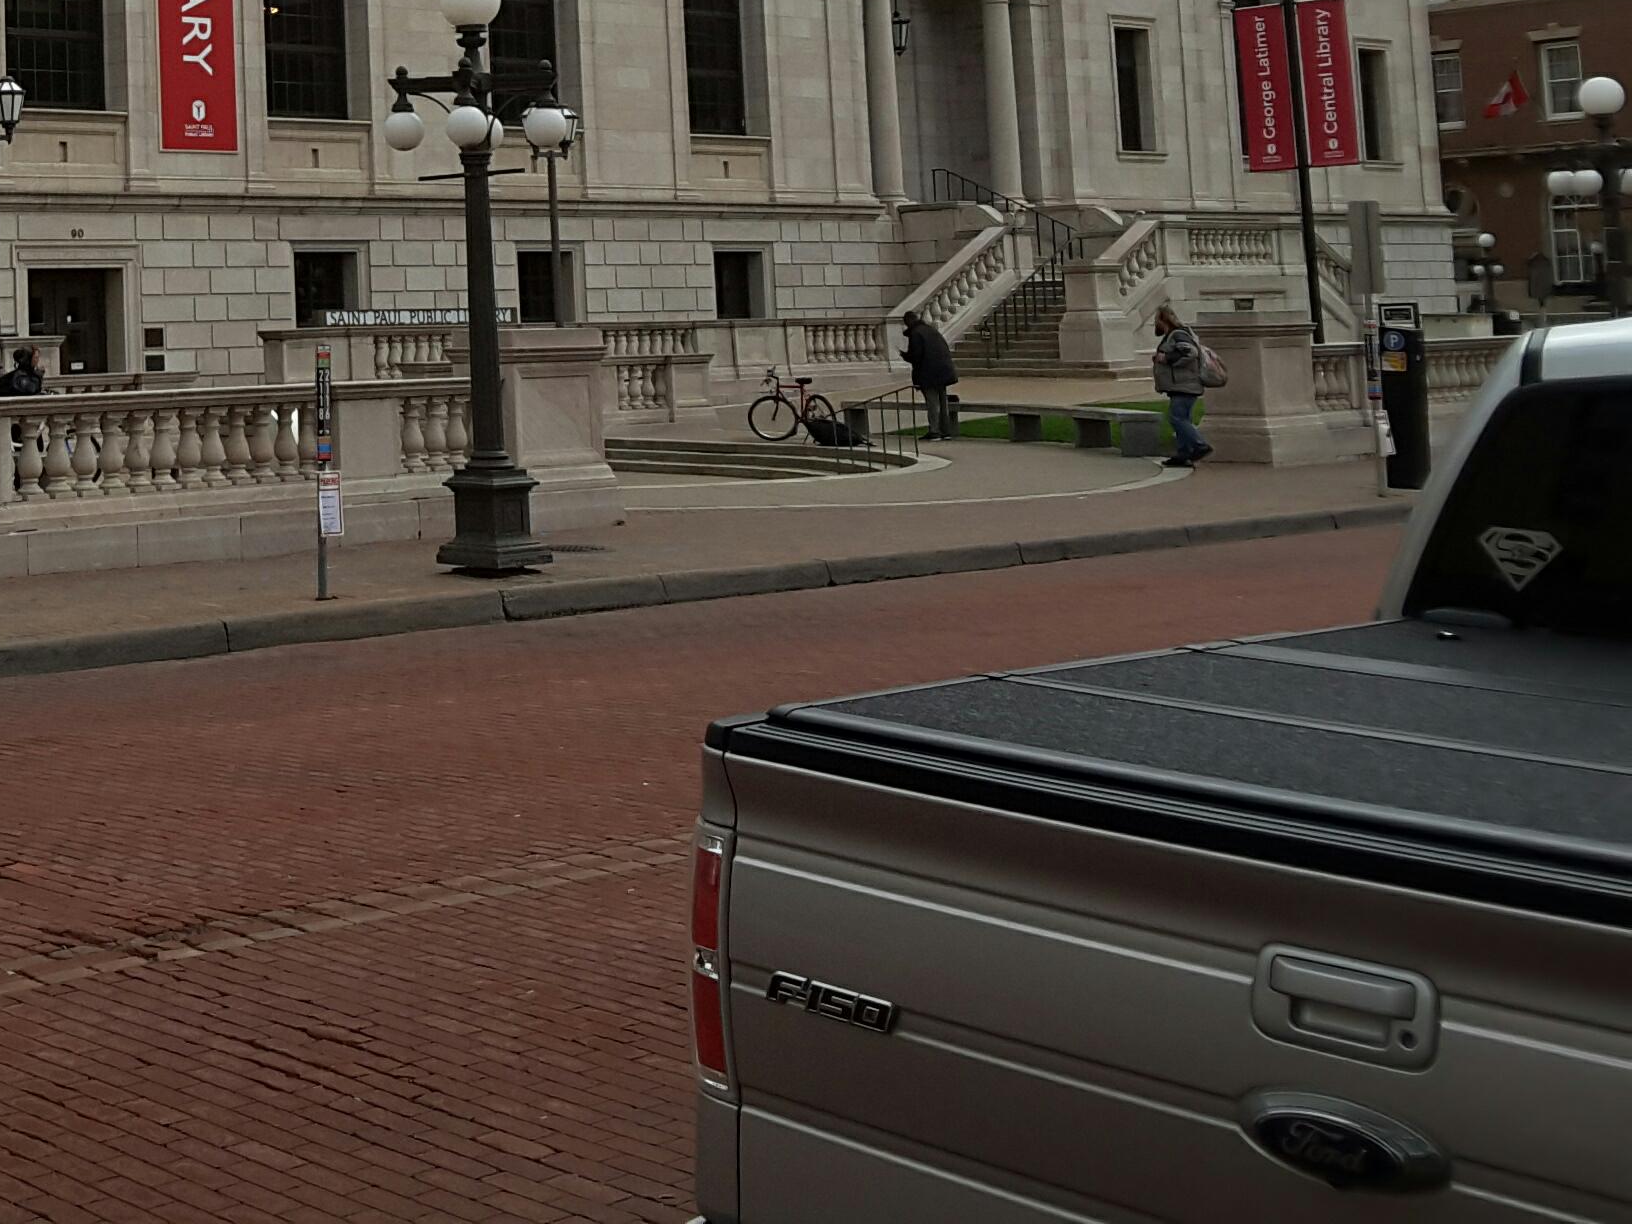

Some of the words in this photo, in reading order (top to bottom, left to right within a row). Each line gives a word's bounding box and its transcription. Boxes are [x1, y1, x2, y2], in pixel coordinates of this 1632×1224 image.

[1254, 15, 1271, 76] Latimer
[1315, 8, 1333, 67] Library
[1261, 79, 1276, 139] George
[1317, 73, 1338, 134] Central
[70, 228, 85, 239] 90
[330, 311, 368, 326] SAINT
[373, 311, 402, 325] PAUL
[409, 310, 452, 325] PUBLIC
[457, 309, 511, 324] LIRY
[767, 970, 893, 1032] F-150
